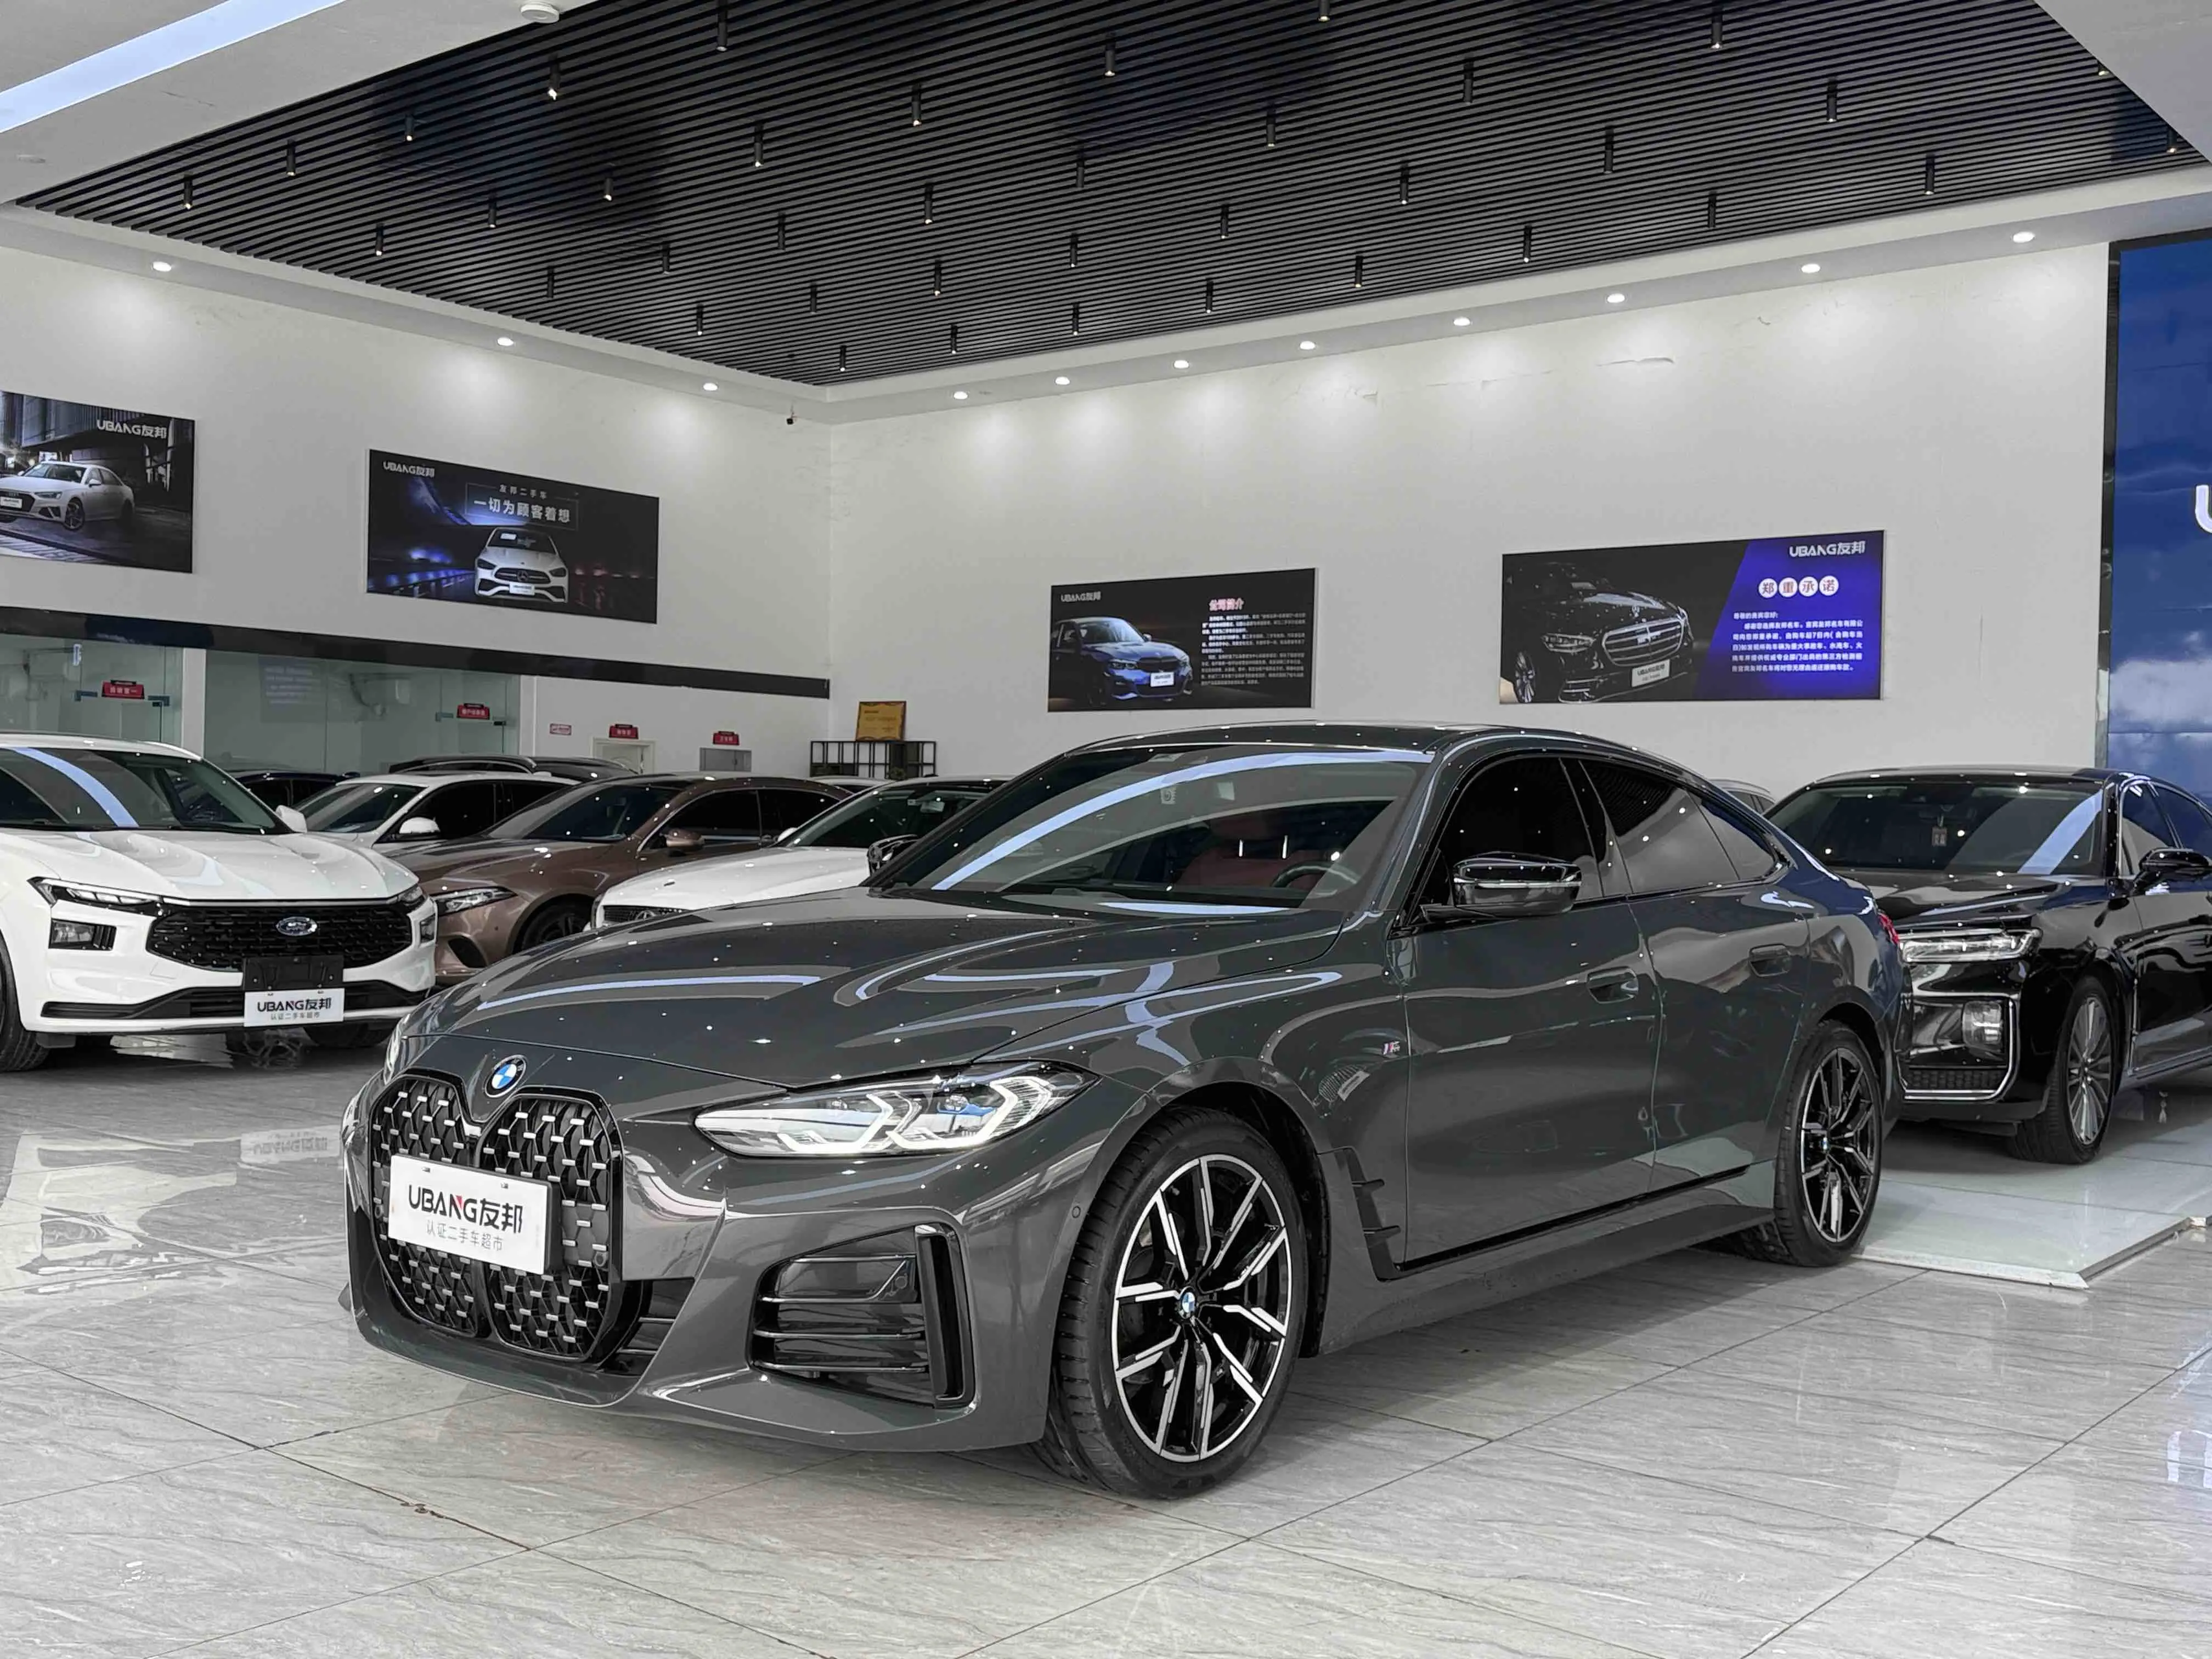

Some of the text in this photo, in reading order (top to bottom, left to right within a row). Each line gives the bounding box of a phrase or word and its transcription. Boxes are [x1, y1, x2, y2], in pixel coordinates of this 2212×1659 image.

[97, 420, 167, 439] UBANG友邦
[473, 496, 571, 523] 一切为顾客着想
[1788, 540, 1866, 557] UBANG友邦
[1762, 579, 1833, 595] 郑重承诺
[257, 997, 332, 1012] UBANG友邦
[408, 1184, 523, 1234] UBANG友邦
[426, 1220, 504, 1251] 认证二手车超市
